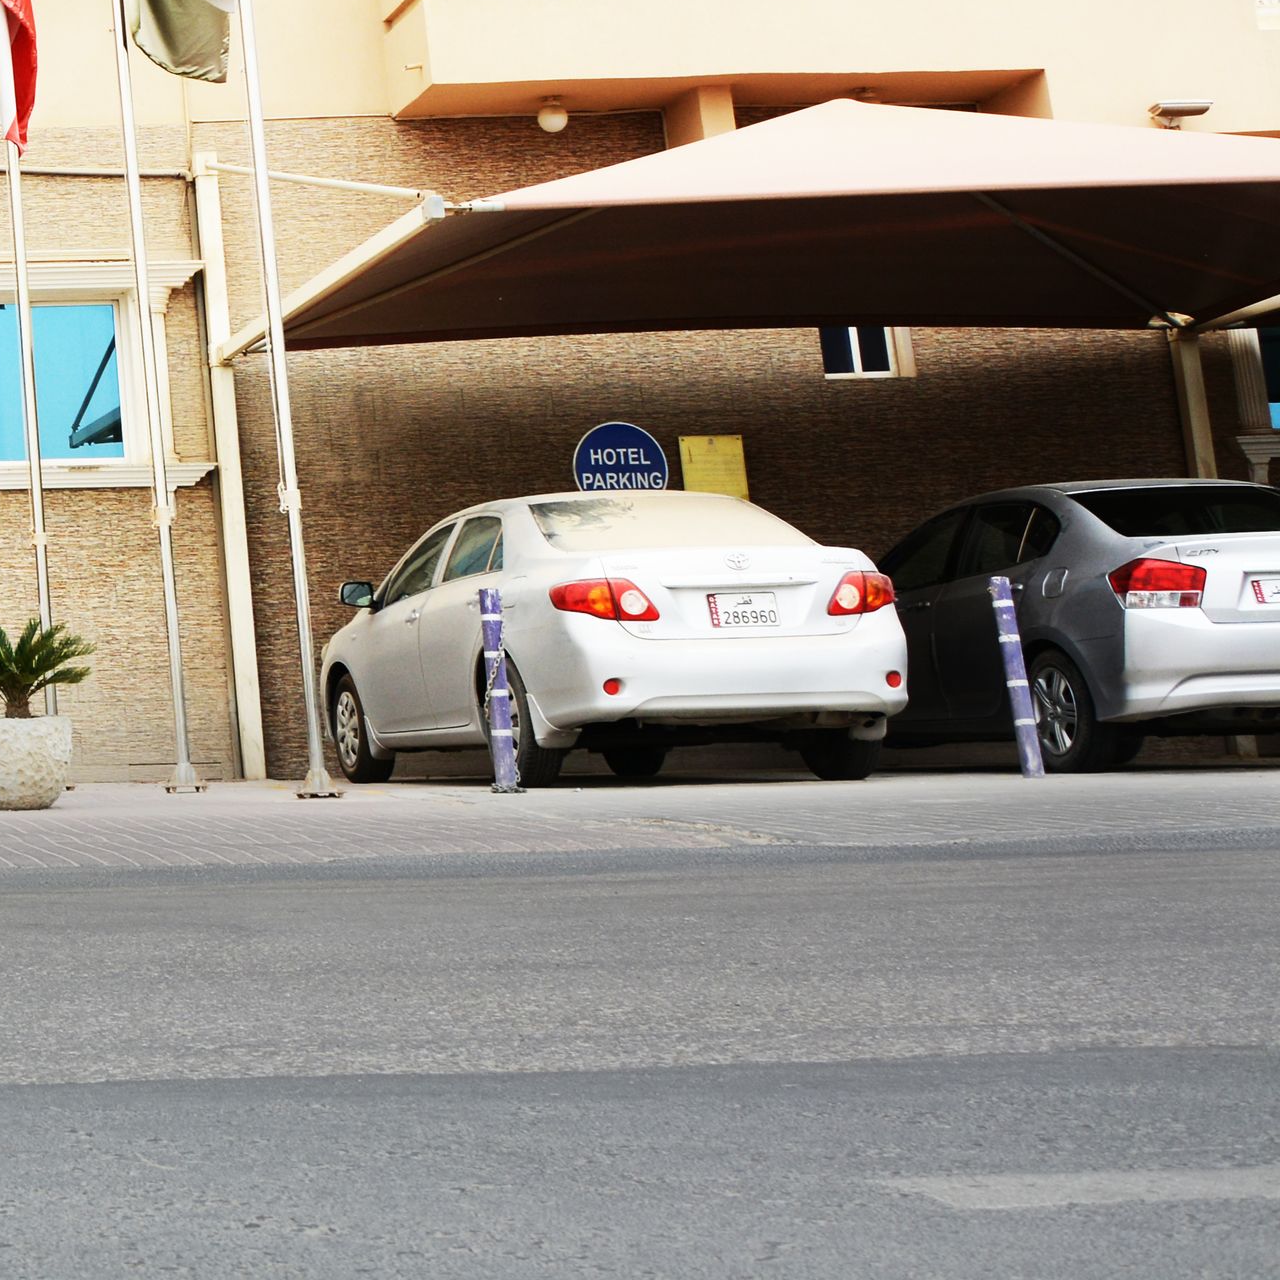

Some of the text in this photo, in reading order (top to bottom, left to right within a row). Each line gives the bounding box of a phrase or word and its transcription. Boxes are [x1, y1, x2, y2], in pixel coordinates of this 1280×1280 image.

[590, 448, 651, 466] HOTEL
[582, 472, 664, 490] PARKING
[723, 609, 777, 625] 286960
